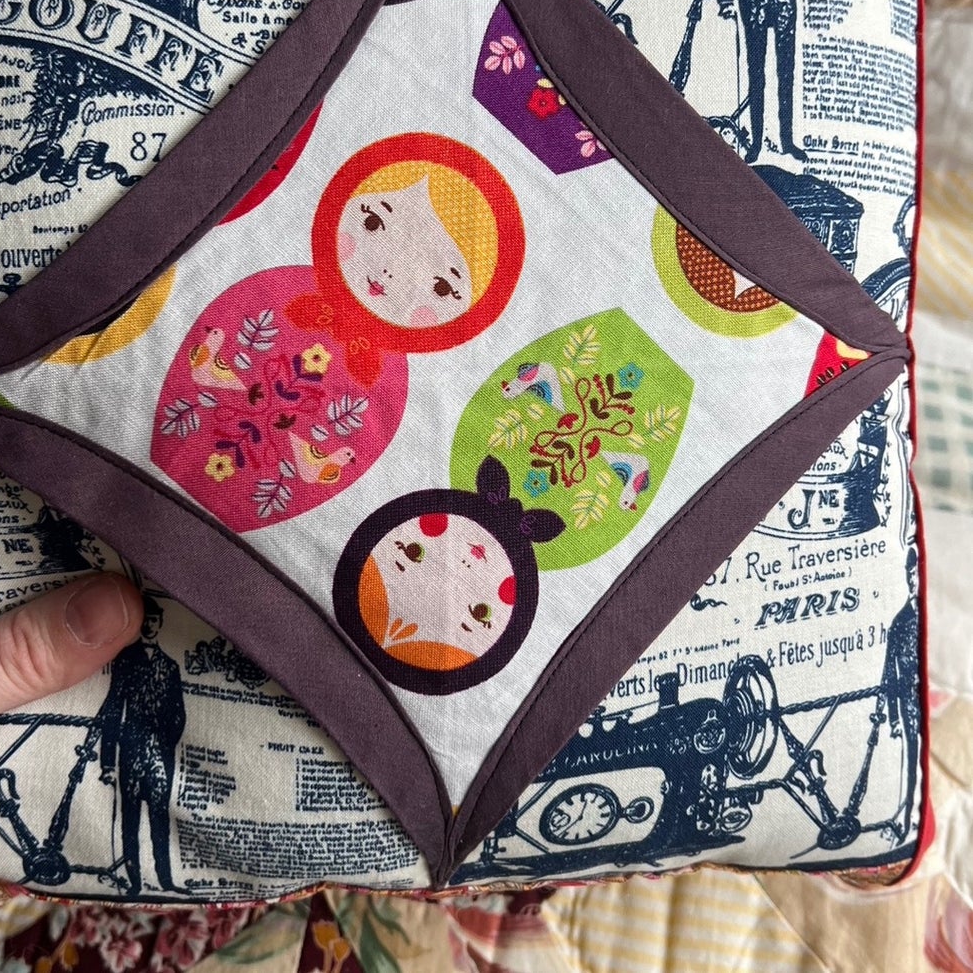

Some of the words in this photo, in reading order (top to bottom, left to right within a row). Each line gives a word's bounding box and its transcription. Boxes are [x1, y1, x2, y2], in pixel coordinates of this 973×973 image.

[81, 100, 175, 137] Commission
[129, 131, 168, 163] 87
[745, 551, 782, 583] Rue
[788, 538, 886, 571] Traversière
[754, 586, 860, 630] PARIS
[765, 648, 776, 669] &
[779, 638, 815, 667] Fêtes
[867, 626, 876, 648] 3
